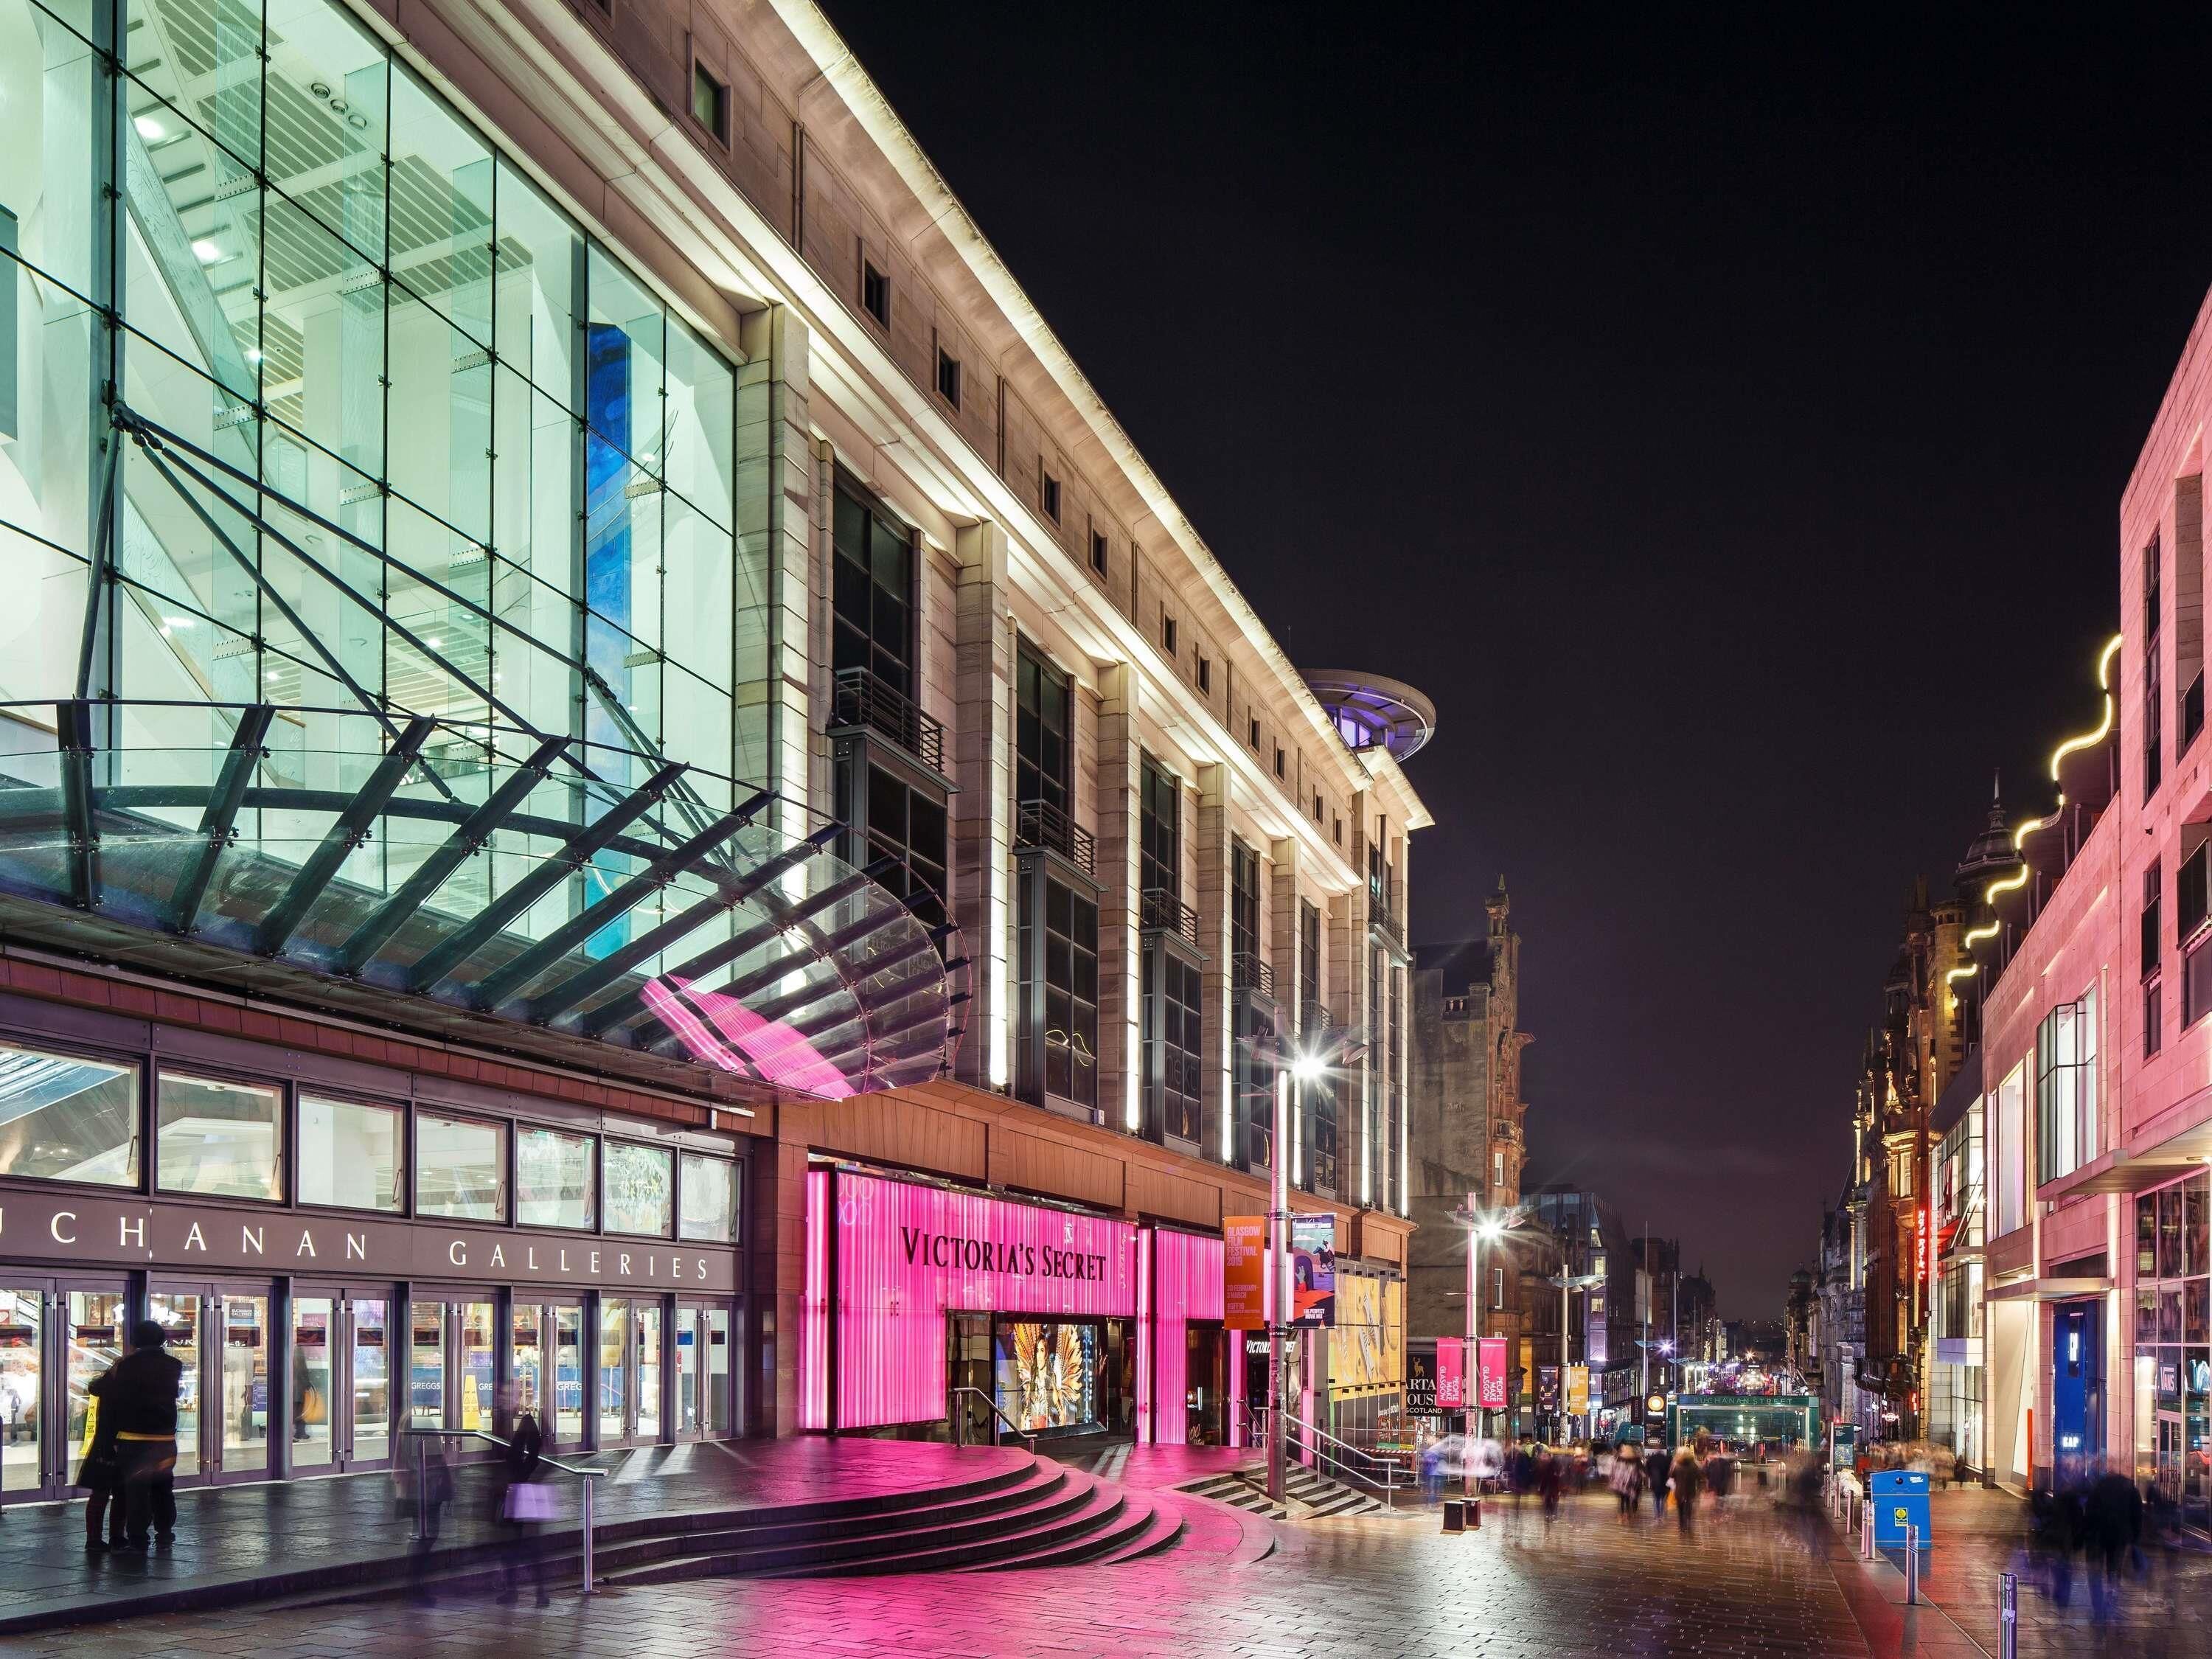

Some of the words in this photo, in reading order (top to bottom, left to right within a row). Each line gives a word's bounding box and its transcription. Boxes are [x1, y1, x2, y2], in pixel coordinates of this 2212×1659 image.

[1165, 1055, 1198, 1091] next
[1227, 1226, 1262, 1237] GLASGOW
[0, 1211, 366, 1261] CHANAN
[449, 1240, 707, 1279] GALLERIES
[1227, 1237, 1242, 1246] FILM
[900, 1226, 1034, 1276] VICTORIA'S
[1042, 1245, 1107, 1281] SECRET
[1227, 1246, 1257, 1256] FESTIVAL
[1227, 1256, 1243, 1266] 2019
[1405, 1378, 1436, 1391] RTA
[2160, 1366, 2174, 1392] VANS
[411, 1382, 441, 1390] GREGGS
[479, 1382, 493, 1391] GRE
[557, 1382, 582, 1391] GREG
[1407, 1394, 1436, 1406] OUS
[1753, 1397, 1793, 1405] STREET
[2062, 1436, 2079, 1447] GAP
